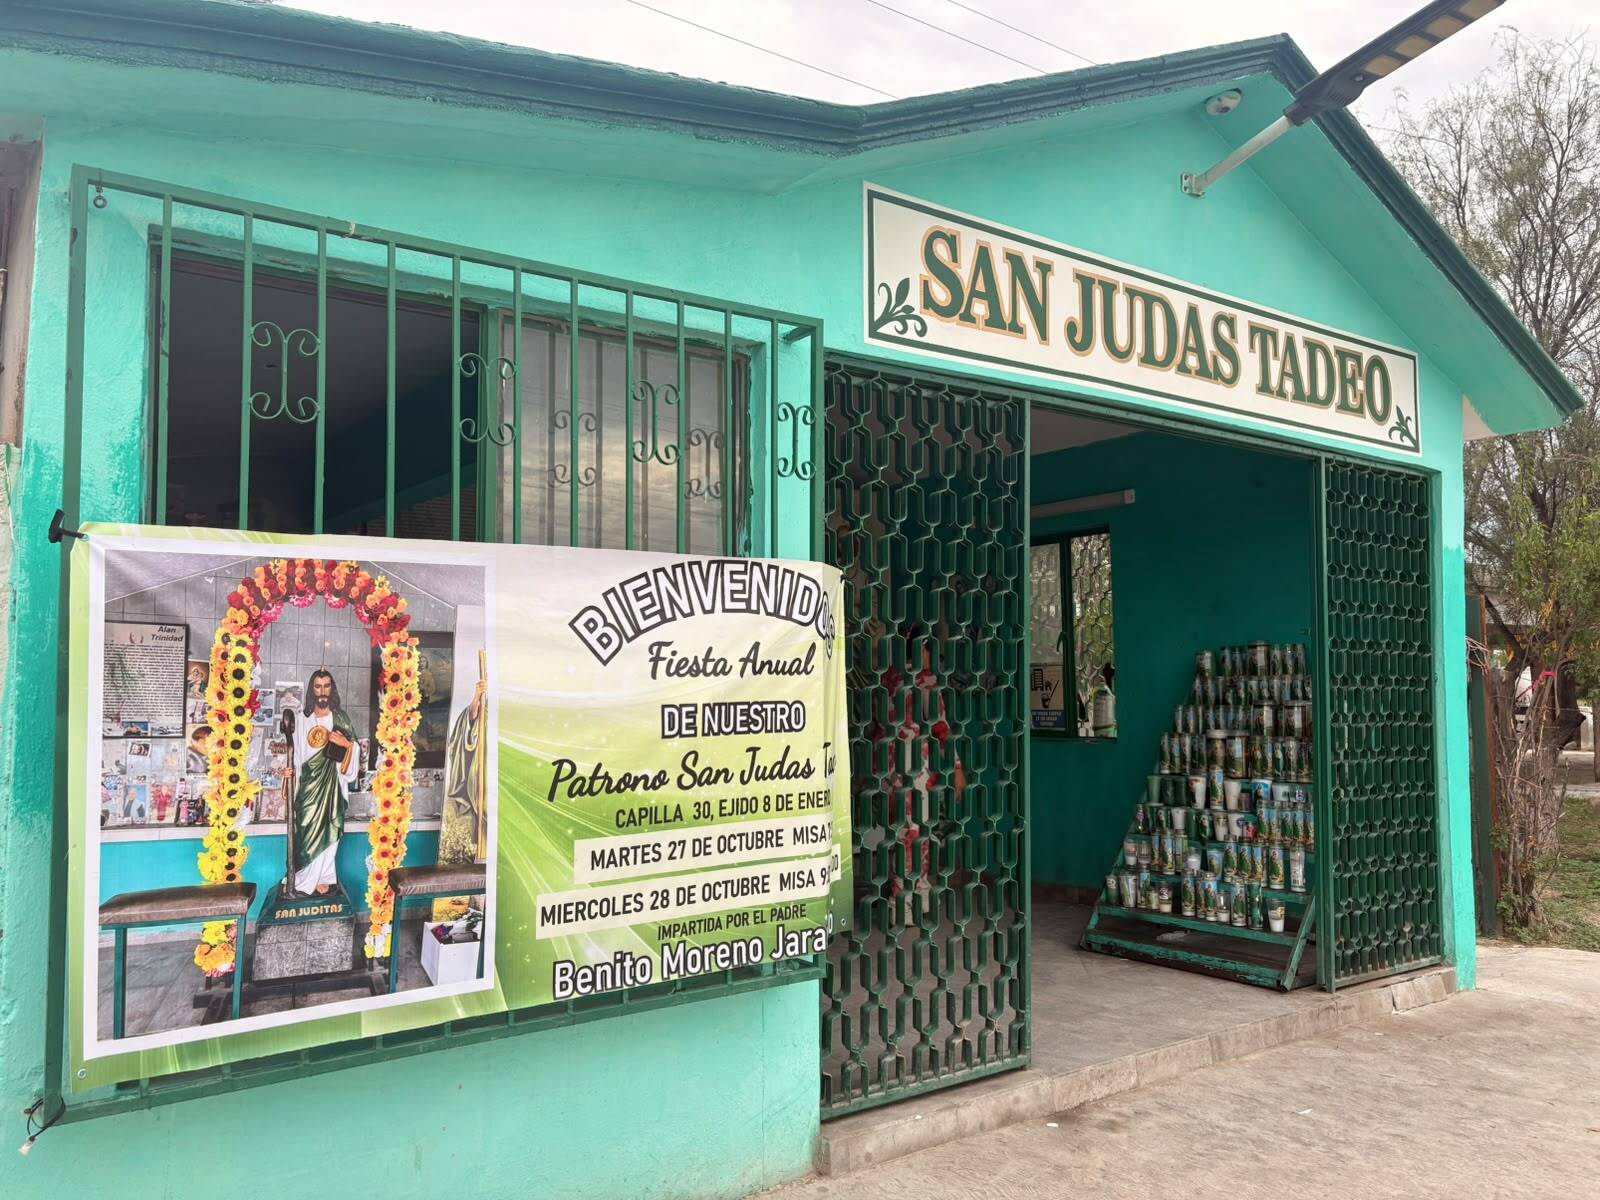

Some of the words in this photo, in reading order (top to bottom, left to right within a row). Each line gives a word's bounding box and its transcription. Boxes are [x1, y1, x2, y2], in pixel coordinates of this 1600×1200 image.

[919, 225, 1053, 346] SAN
[1065, 267, 1241, 388] JUDAS
[1248, 322, 1392, 426] TADEO
[151, 634, 183, 642] Trinidad
[648, 641, 732, 680] Fiesta
[739, 641, 816, 679] Anual
[661, 704, 697, 739] DE
[702, 700, 806, 737] NUESTRO
[548, 759, 669, 802] Patrono
[677, 751, 734, 791] San
[740, 745, 816, 783] Judas
[615, 804, 684, 828] CAPILLA
[693, 801, 714, 821] 30,
[719, 796, 758, 817] EJIDO
[763, 795, 771, 812] 8
[776, 794, 793, 811] DE
[591, 843, 662, 870] MARTES
[668, 839, 687, 860] 27
[692, 837, 712, 857] DE
[717, 829, 784, 853] OCTUBRE
[793, 824, 826, 845] MISA
[275, 909, 296, 919] SAN
[298, 904, 343, 916] JUDITAS
[541, 893, 644, 927] MIERCOLES
[650, 889, 670, 910] 28
[676, 885, 696, 906] DE
[702, 875, 770, 902] OCTUBRE
[780, 869, 816, 891] MISA
[658, 916, 722, 940] IMPARTIDA
[726, 912, 749, 929] POR
[753, 910, 766, 925] EL
[770, 904, 806, 922] PADRE
[553, 951, 652, 1000] Benito
[661, 937, 763, 980] Moreno
